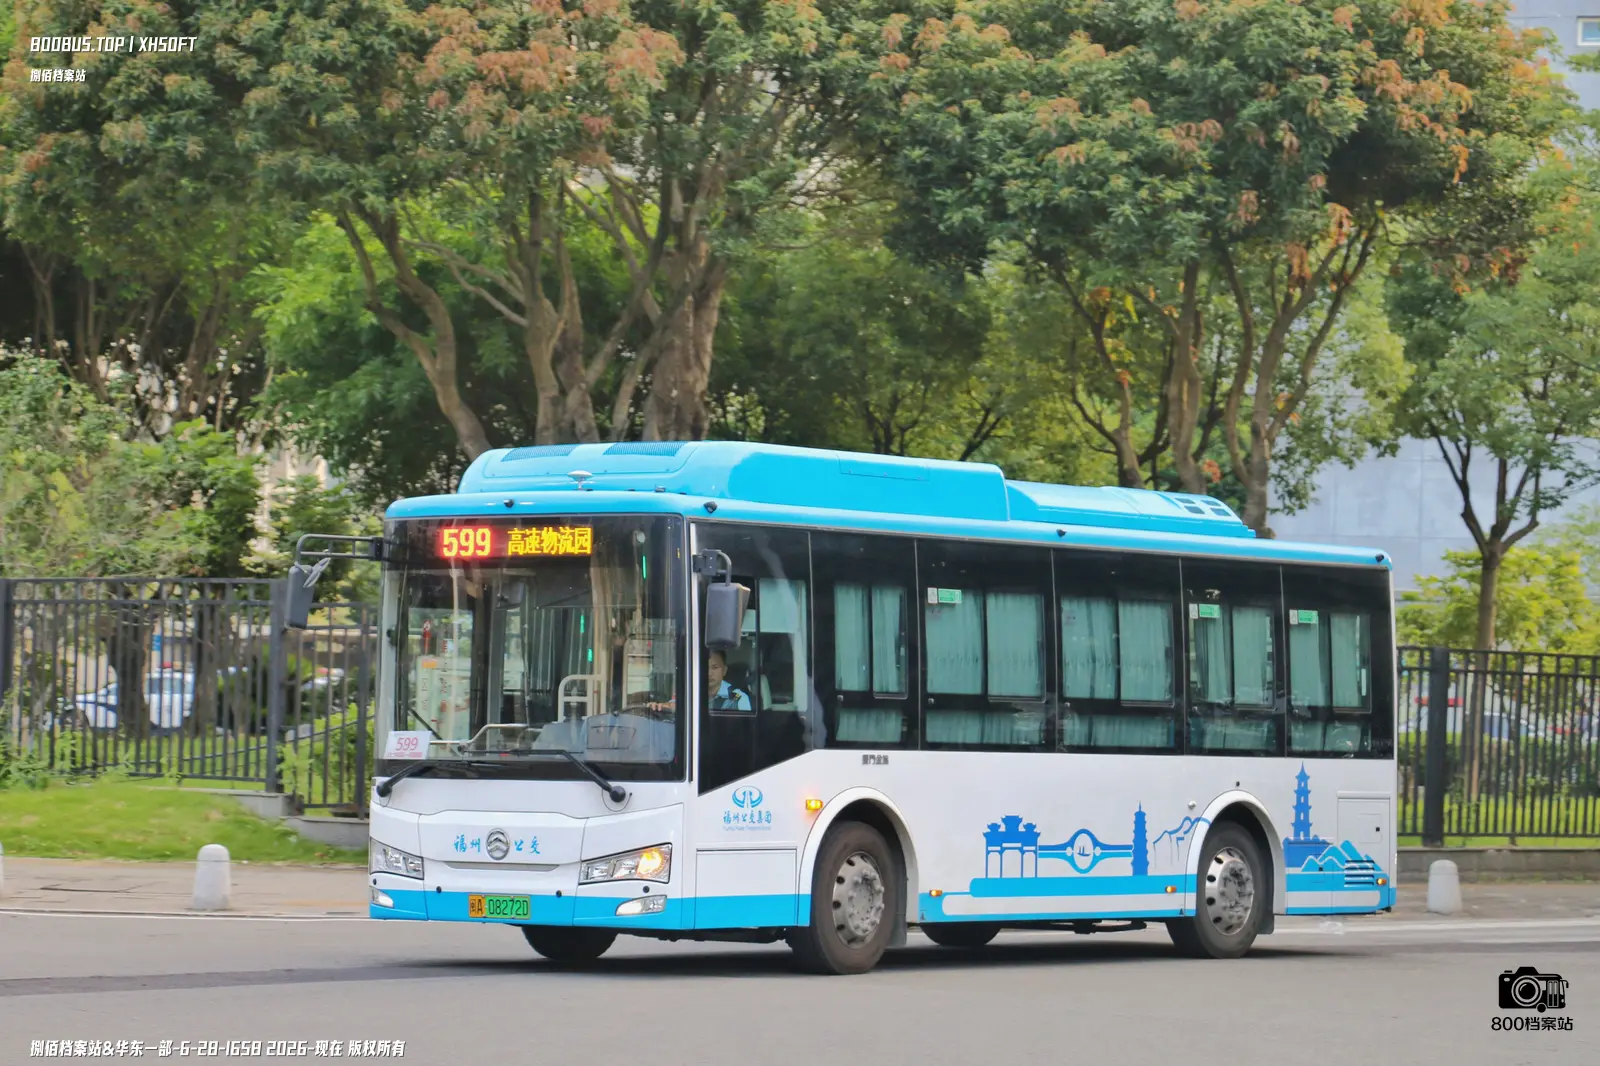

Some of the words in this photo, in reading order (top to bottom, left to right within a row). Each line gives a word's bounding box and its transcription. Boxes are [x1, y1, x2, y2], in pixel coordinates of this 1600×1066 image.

[443, 527, 491, 557] 599
[507, 527, 592, 555] 高速物流园
[395, 736, 418, 751] 599
[453, 834, 481, 853] 福州
[514, 836, 540, 854] 公交
